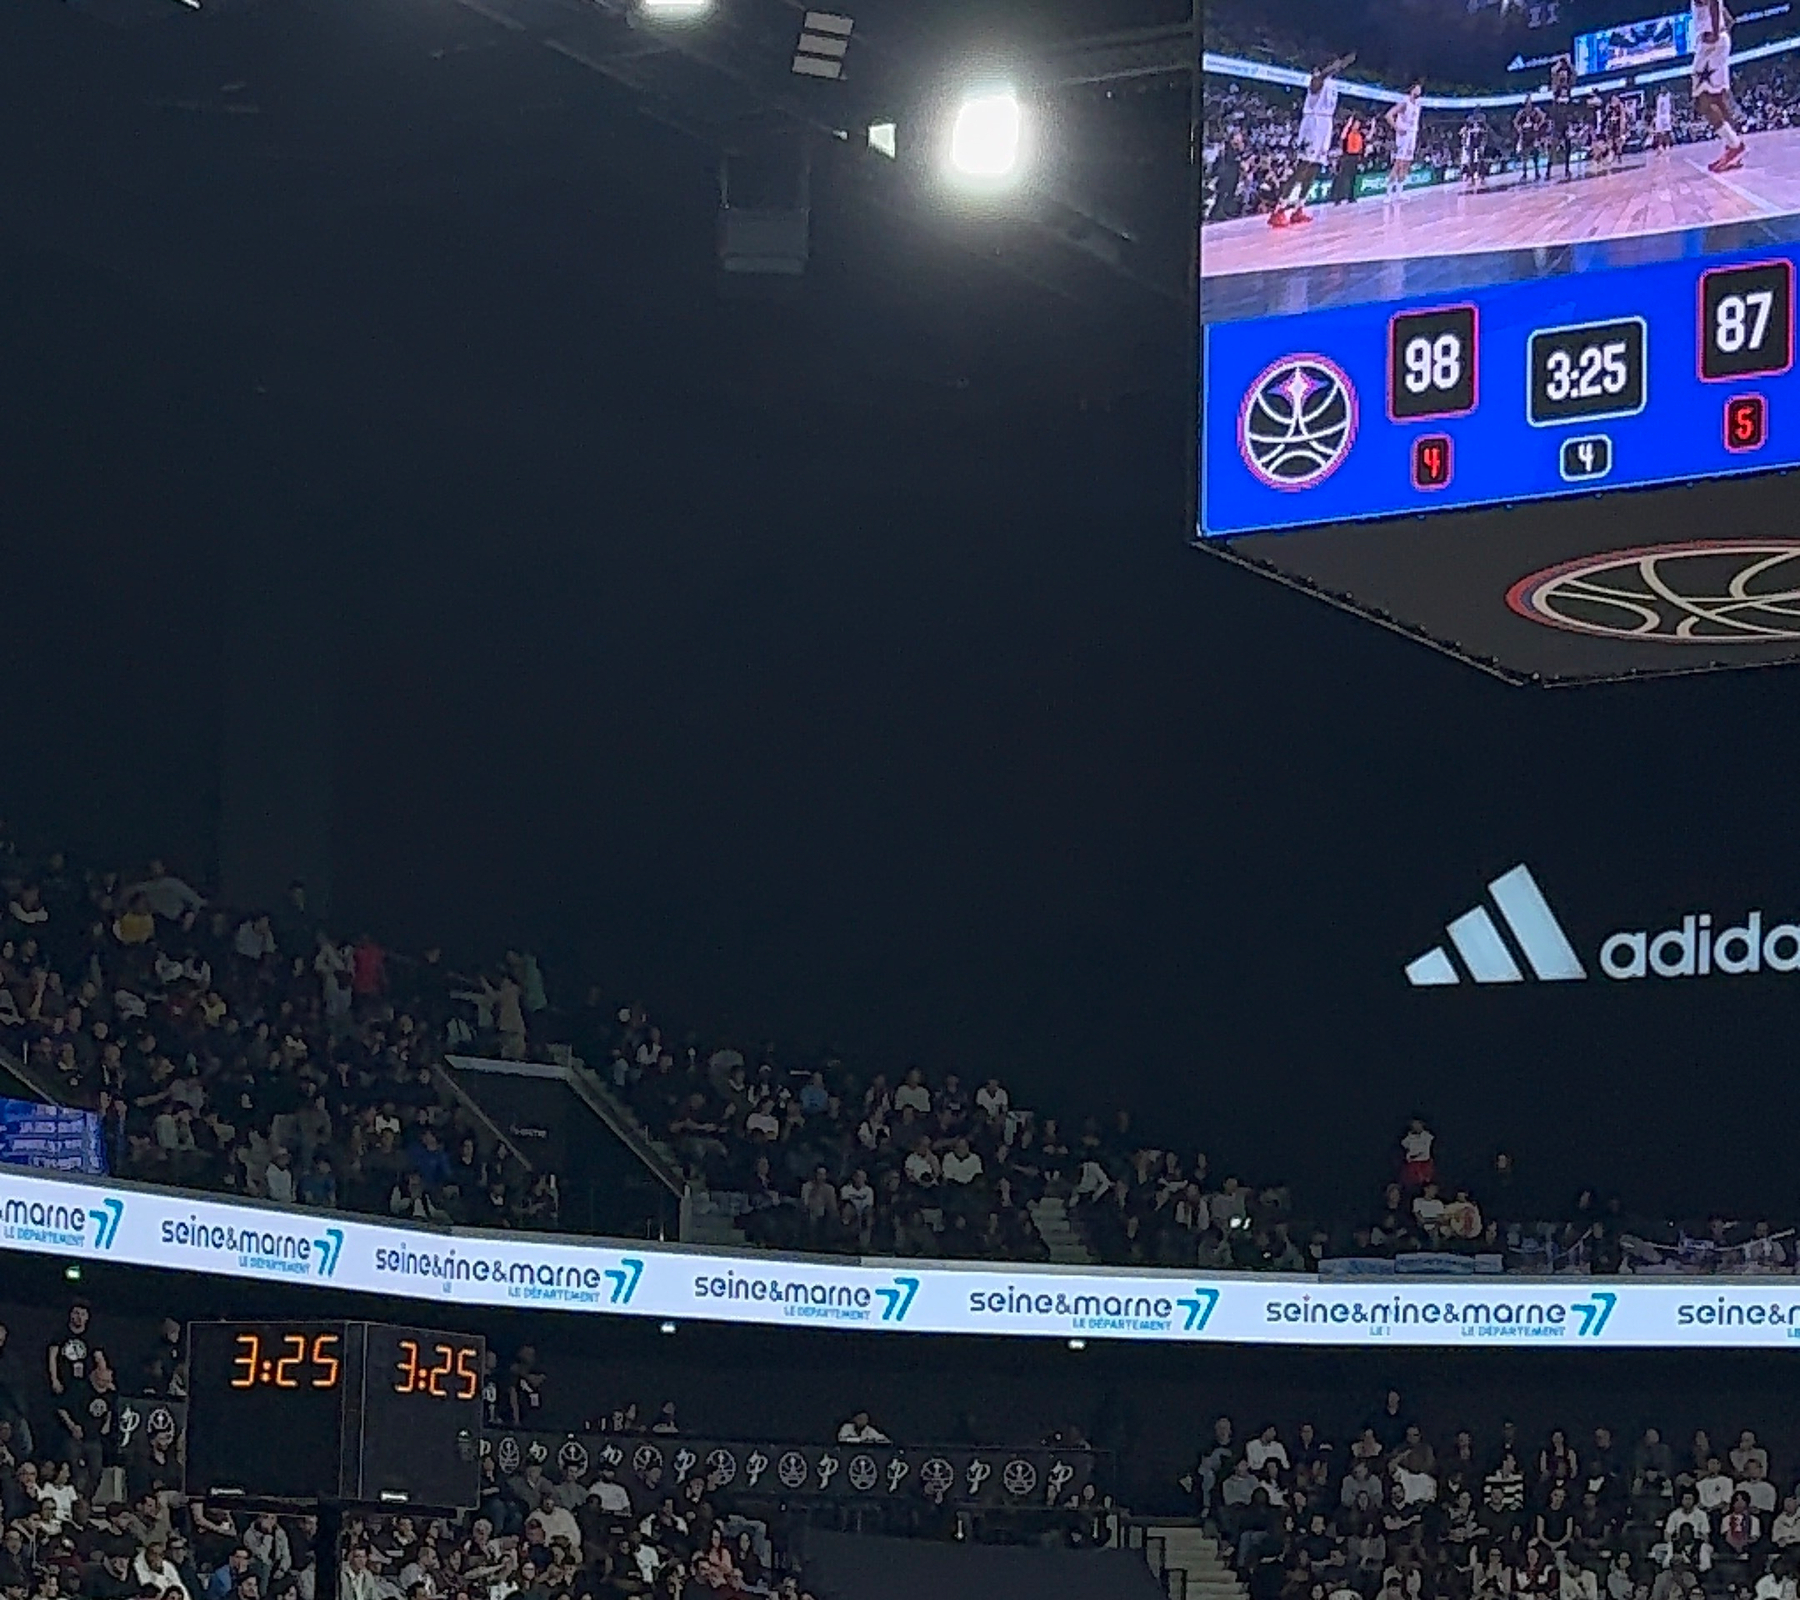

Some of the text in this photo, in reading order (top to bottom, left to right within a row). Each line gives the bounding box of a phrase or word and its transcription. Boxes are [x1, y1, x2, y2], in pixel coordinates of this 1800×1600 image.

[1716, 292, 1773, 352] 87
[1405, 333, 1461, 393] 98
[1546, 344, 1627, 400] 3:25
[1735, 408, 1752, 439] 5
[1424, 447, 1440, 478] 4
[1578, 441, 1593, 472] 4
[695, 1270, 871, 1308] seine&marne
[970, 1286, 1172, 1318] seine&marne
[231, 1336, 339, 1386] 3:25
[395, 1341, 477, 1399] 3:25
